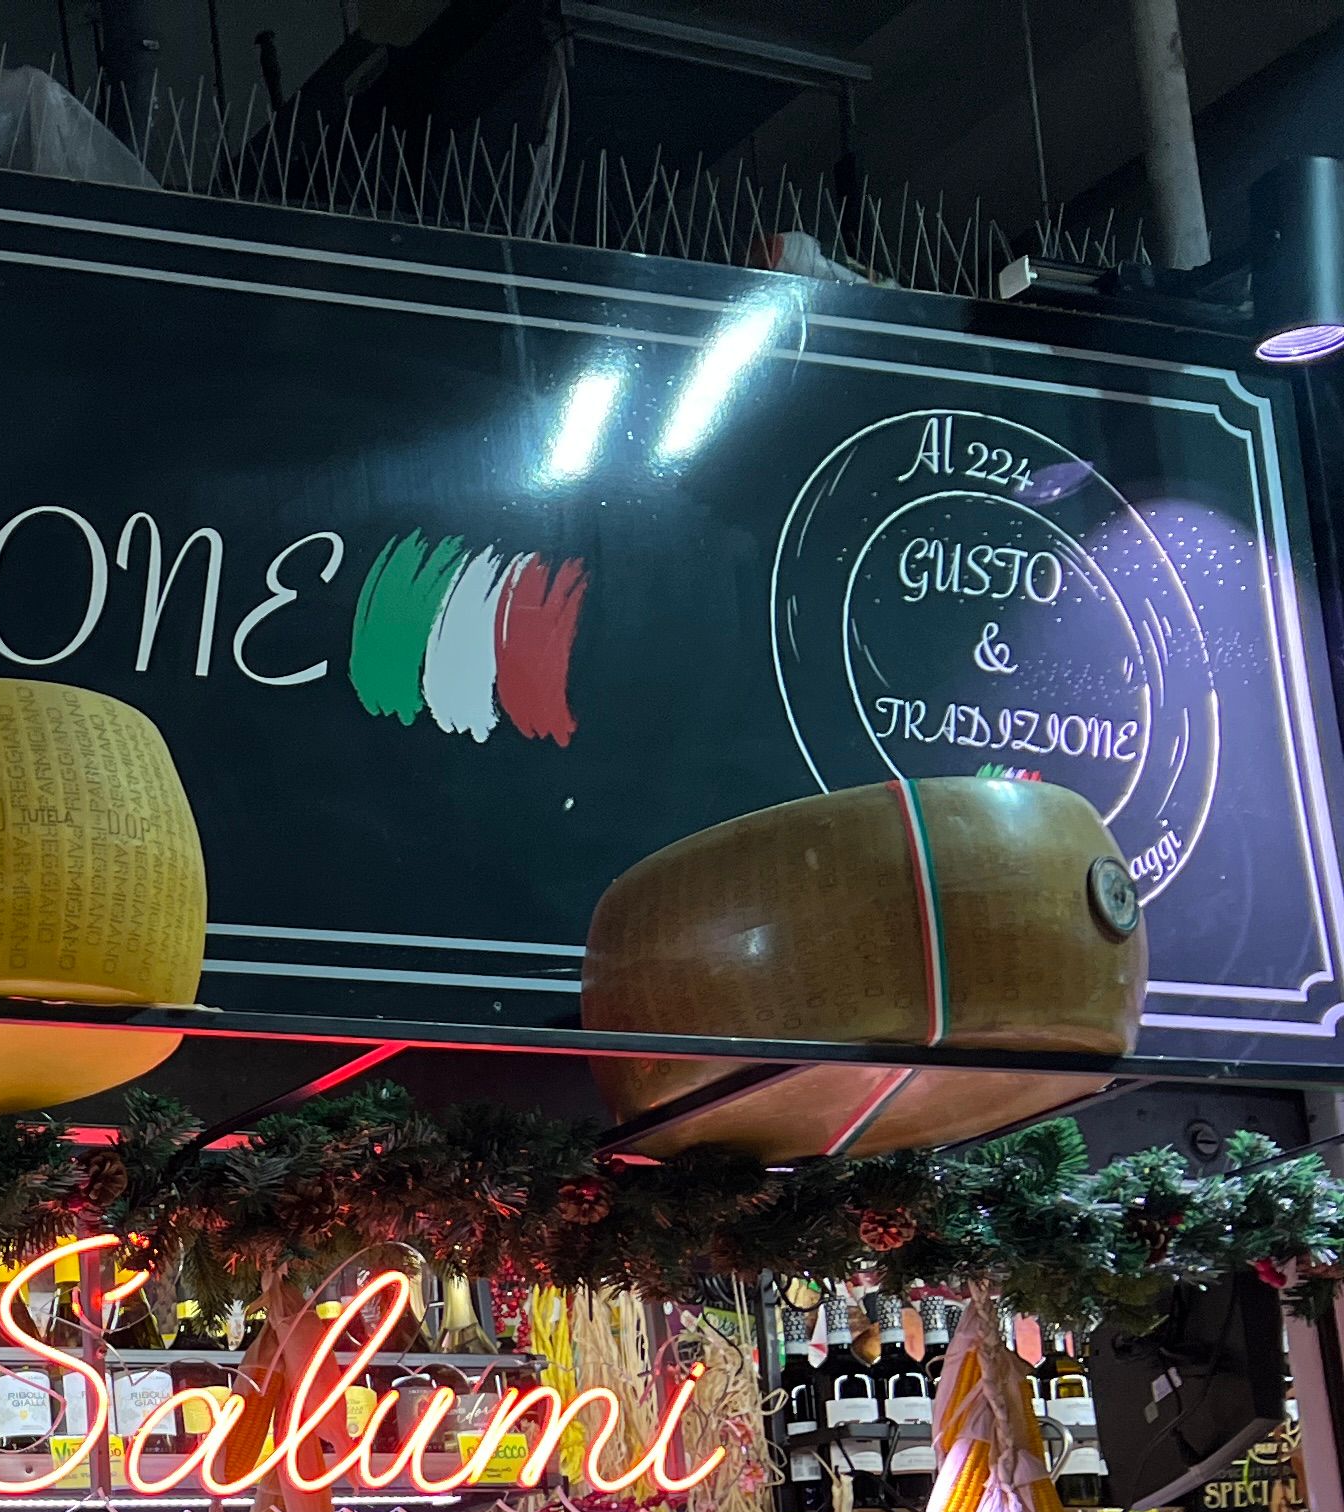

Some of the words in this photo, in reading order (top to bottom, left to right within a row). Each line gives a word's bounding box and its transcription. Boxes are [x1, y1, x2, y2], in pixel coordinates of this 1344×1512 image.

[899, 417, 955, 482] Al
[966, 442, 1035, 492] 224
[899, 538, 1063, 604] GUSTO
[974, 622, 1018, 673] &
[876, 696, 1138, 761] TRADIZIONE
[21, 808, 74, 826] TUTELA
[1128, 828, 1182, 880] aggi
[1204, 1478, 1304, 1509] SPECIL
